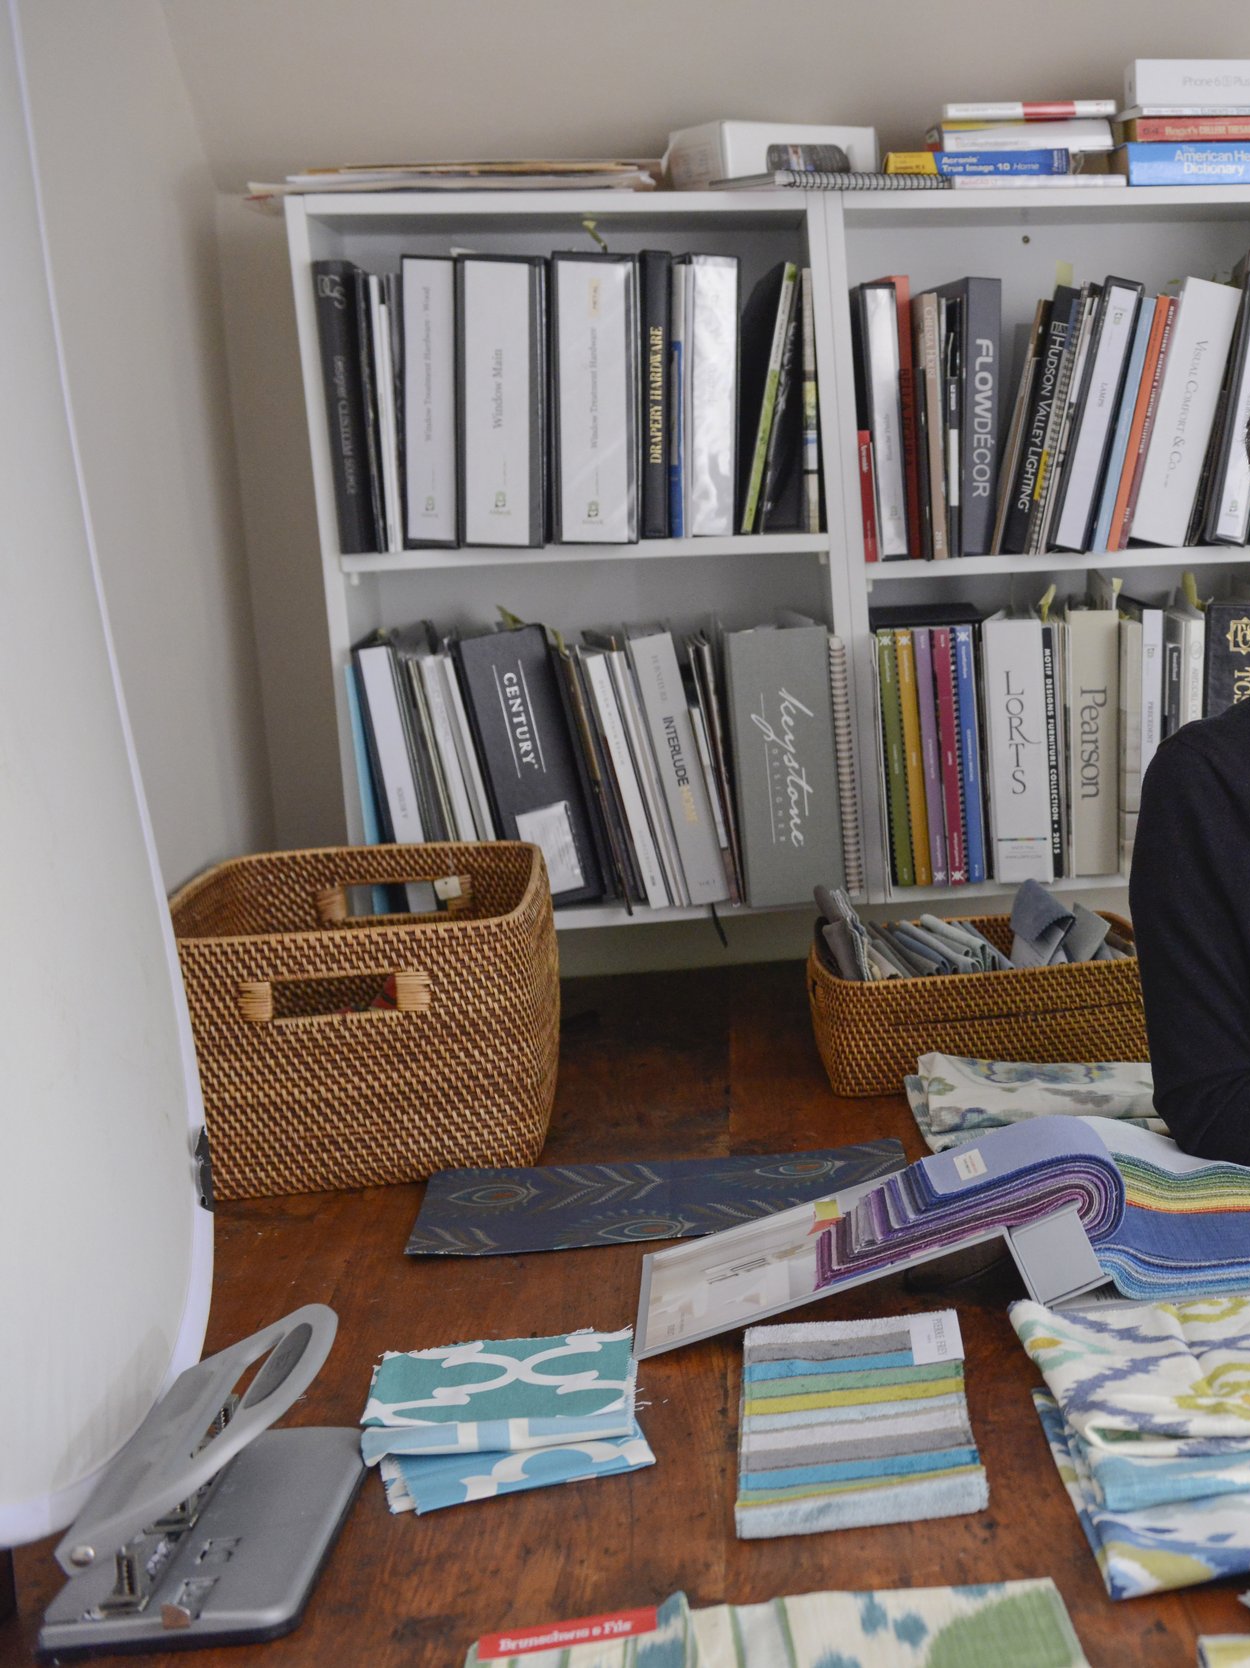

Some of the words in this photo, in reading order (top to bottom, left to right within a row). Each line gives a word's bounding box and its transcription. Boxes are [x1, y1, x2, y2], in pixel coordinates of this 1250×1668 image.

[1182, 75, 1212, 87] iPhone
[1233, 75, 1250, 87] Plus
[942, 164, 963, 173] True
[965, 163, 994, 174] Image
[1012, 162, 1041, 172] Home
[1175, 150, 1233, 162] American
[1183, 162, 1245, 177] Dictionary
[491, 348, 504, 379] Main
[649, 326, 664, 394] HARDWARE
[1041, 335, 1066, 396] HUDSON
[1189, 339, 1209, 379] VISUAL
[491, 381, 504, 429] Window
[972, 338, 994, 498] FLOWDÉCOR
[1031, 399, 1054, 447] VALLEY
[1174, 380, 1200, 434] COMFORT
[649, 397, 664, 464] DRAPERY
[1171, 434, 1187, 449] &
[1018, 446, 1043, 513] LIGHTING
[1044, 648, 1052, 677] MOTIF
[503, 671, 537, 768] CENTURY
[1045, 677, 1054, 718] DESIGNS
[1004, 670, 1042, 796] LORTS
[1047, 718, 1057, 767] FURNITURE
[1080, 685, 1108, 800] Pearson
[1050, 768, 1059, 821] COLLECTION
